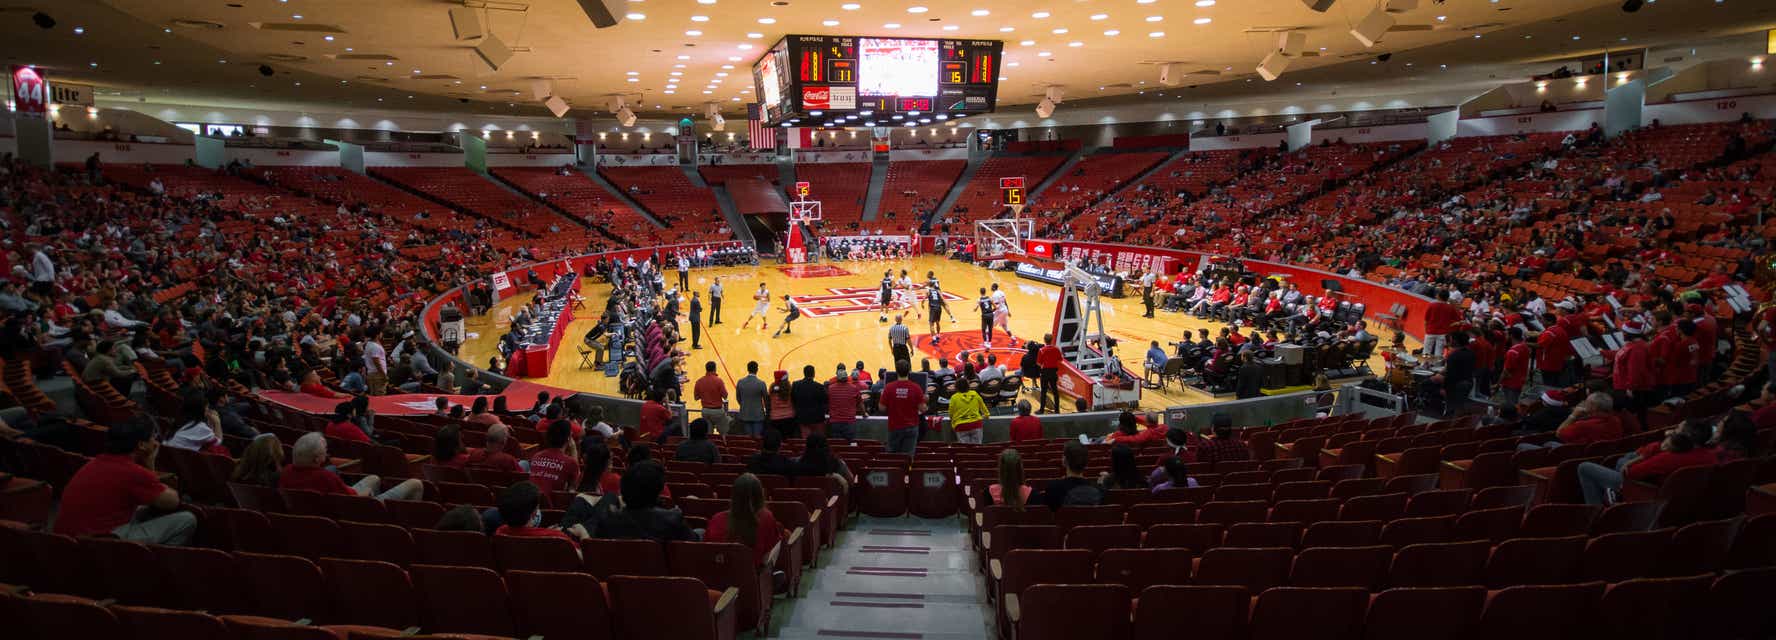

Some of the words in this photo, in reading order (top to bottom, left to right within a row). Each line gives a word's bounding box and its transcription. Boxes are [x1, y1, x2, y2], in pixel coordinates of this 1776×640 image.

[840, 70, 851, 81] 11
[951, 72, 961, 83] 15
[18, 82, 43, 105] 44
[1009, 189, 1020, 204] 15
